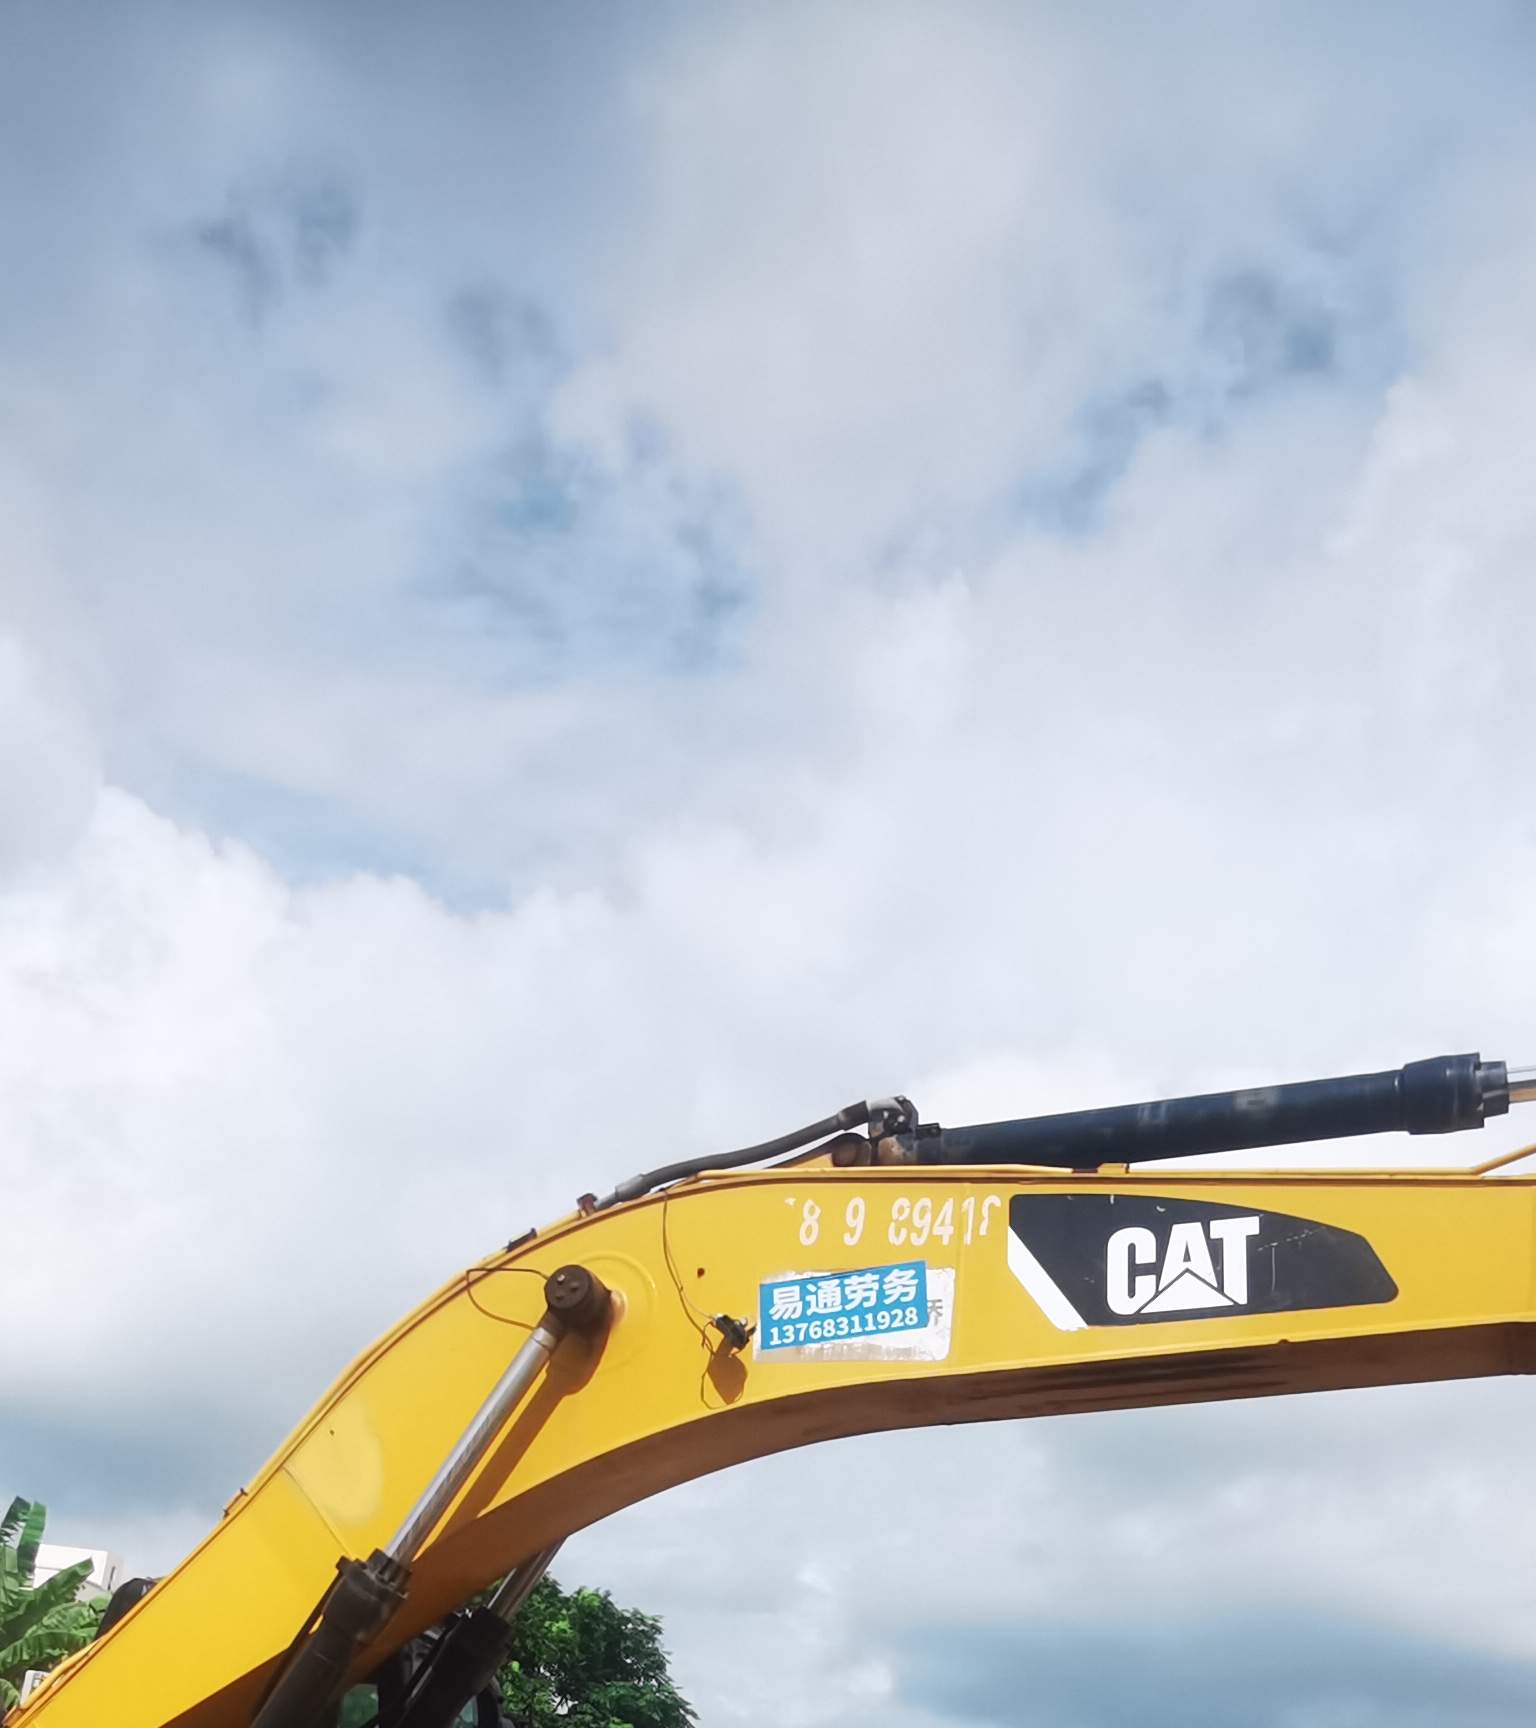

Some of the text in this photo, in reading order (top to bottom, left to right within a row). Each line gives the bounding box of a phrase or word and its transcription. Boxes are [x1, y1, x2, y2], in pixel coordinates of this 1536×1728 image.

[1106, 1216, 1260, 1315] CAT
[769, 1268, 919, 1321] 易通劳务
[769, 1306, 919, 1346] 13768311928
